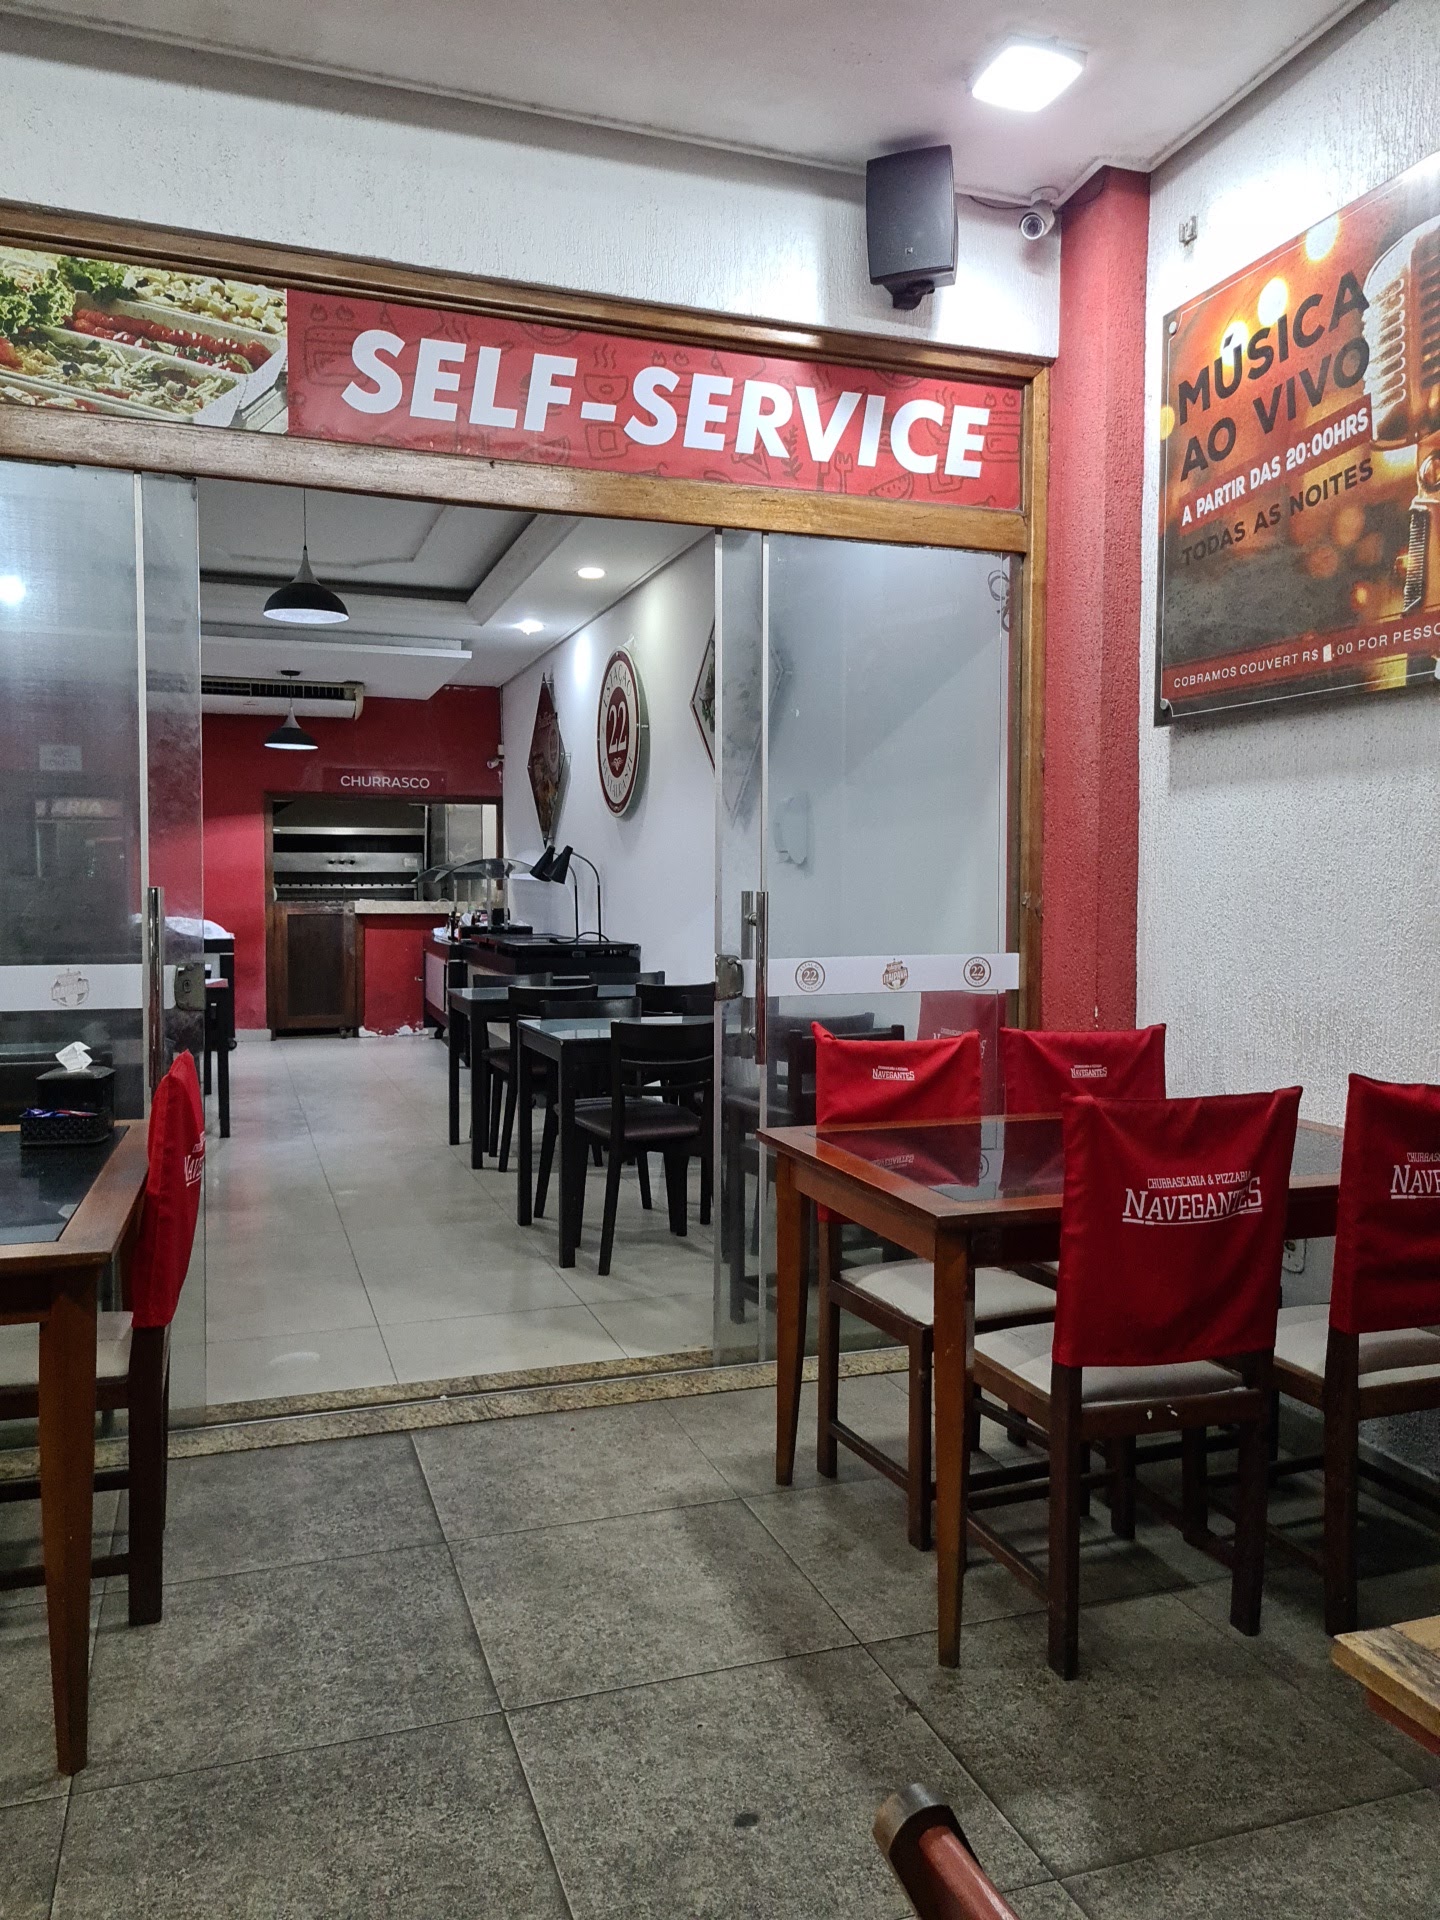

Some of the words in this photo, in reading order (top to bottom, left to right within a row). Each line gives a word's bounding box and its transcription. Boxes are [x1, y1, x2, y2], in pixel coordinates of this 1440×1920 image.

[1178, 270, 1370, 426] MÚSICA
[341, 330, 990, 478] SELF-SERVICE
[1180, 416, 1237, 482] AO
[1252, 337, 1370, 434] VIVO
[1181, 505, 1192, 527] A
[1196, 476, 1245, 519] PARTIR
[1249, 456, 1281, 493] DAS
[1286, 408, 1369, 472] 20:00HRS
[1182, 521, 1246, 566] TODAS
[1253, 503, 1281, 534] AS
[1290, 458, 1373, 517] NOITES
[1173, 666, 1237, 688] COBRAMOS
[1239, 653, 1298, 676] COUVERT
[1302, 648, 1319, 663] R$
[1358, 634, 1388, 652] POR
[608, 701, 627, 754] 22
[340, 775, 430, 789] CHURRASCO
[803, 970, 817, 981] 22
[971, 966, 984, 976] 22
[872, 1068, 915, 1080] NAVEGANTES
[1122, 1176, 1262, 1220] NAVEGANTES
[1147, 1175, 1207, 1189] CHURRASCARIA
[1207, 1174, 1214, 1185] &
